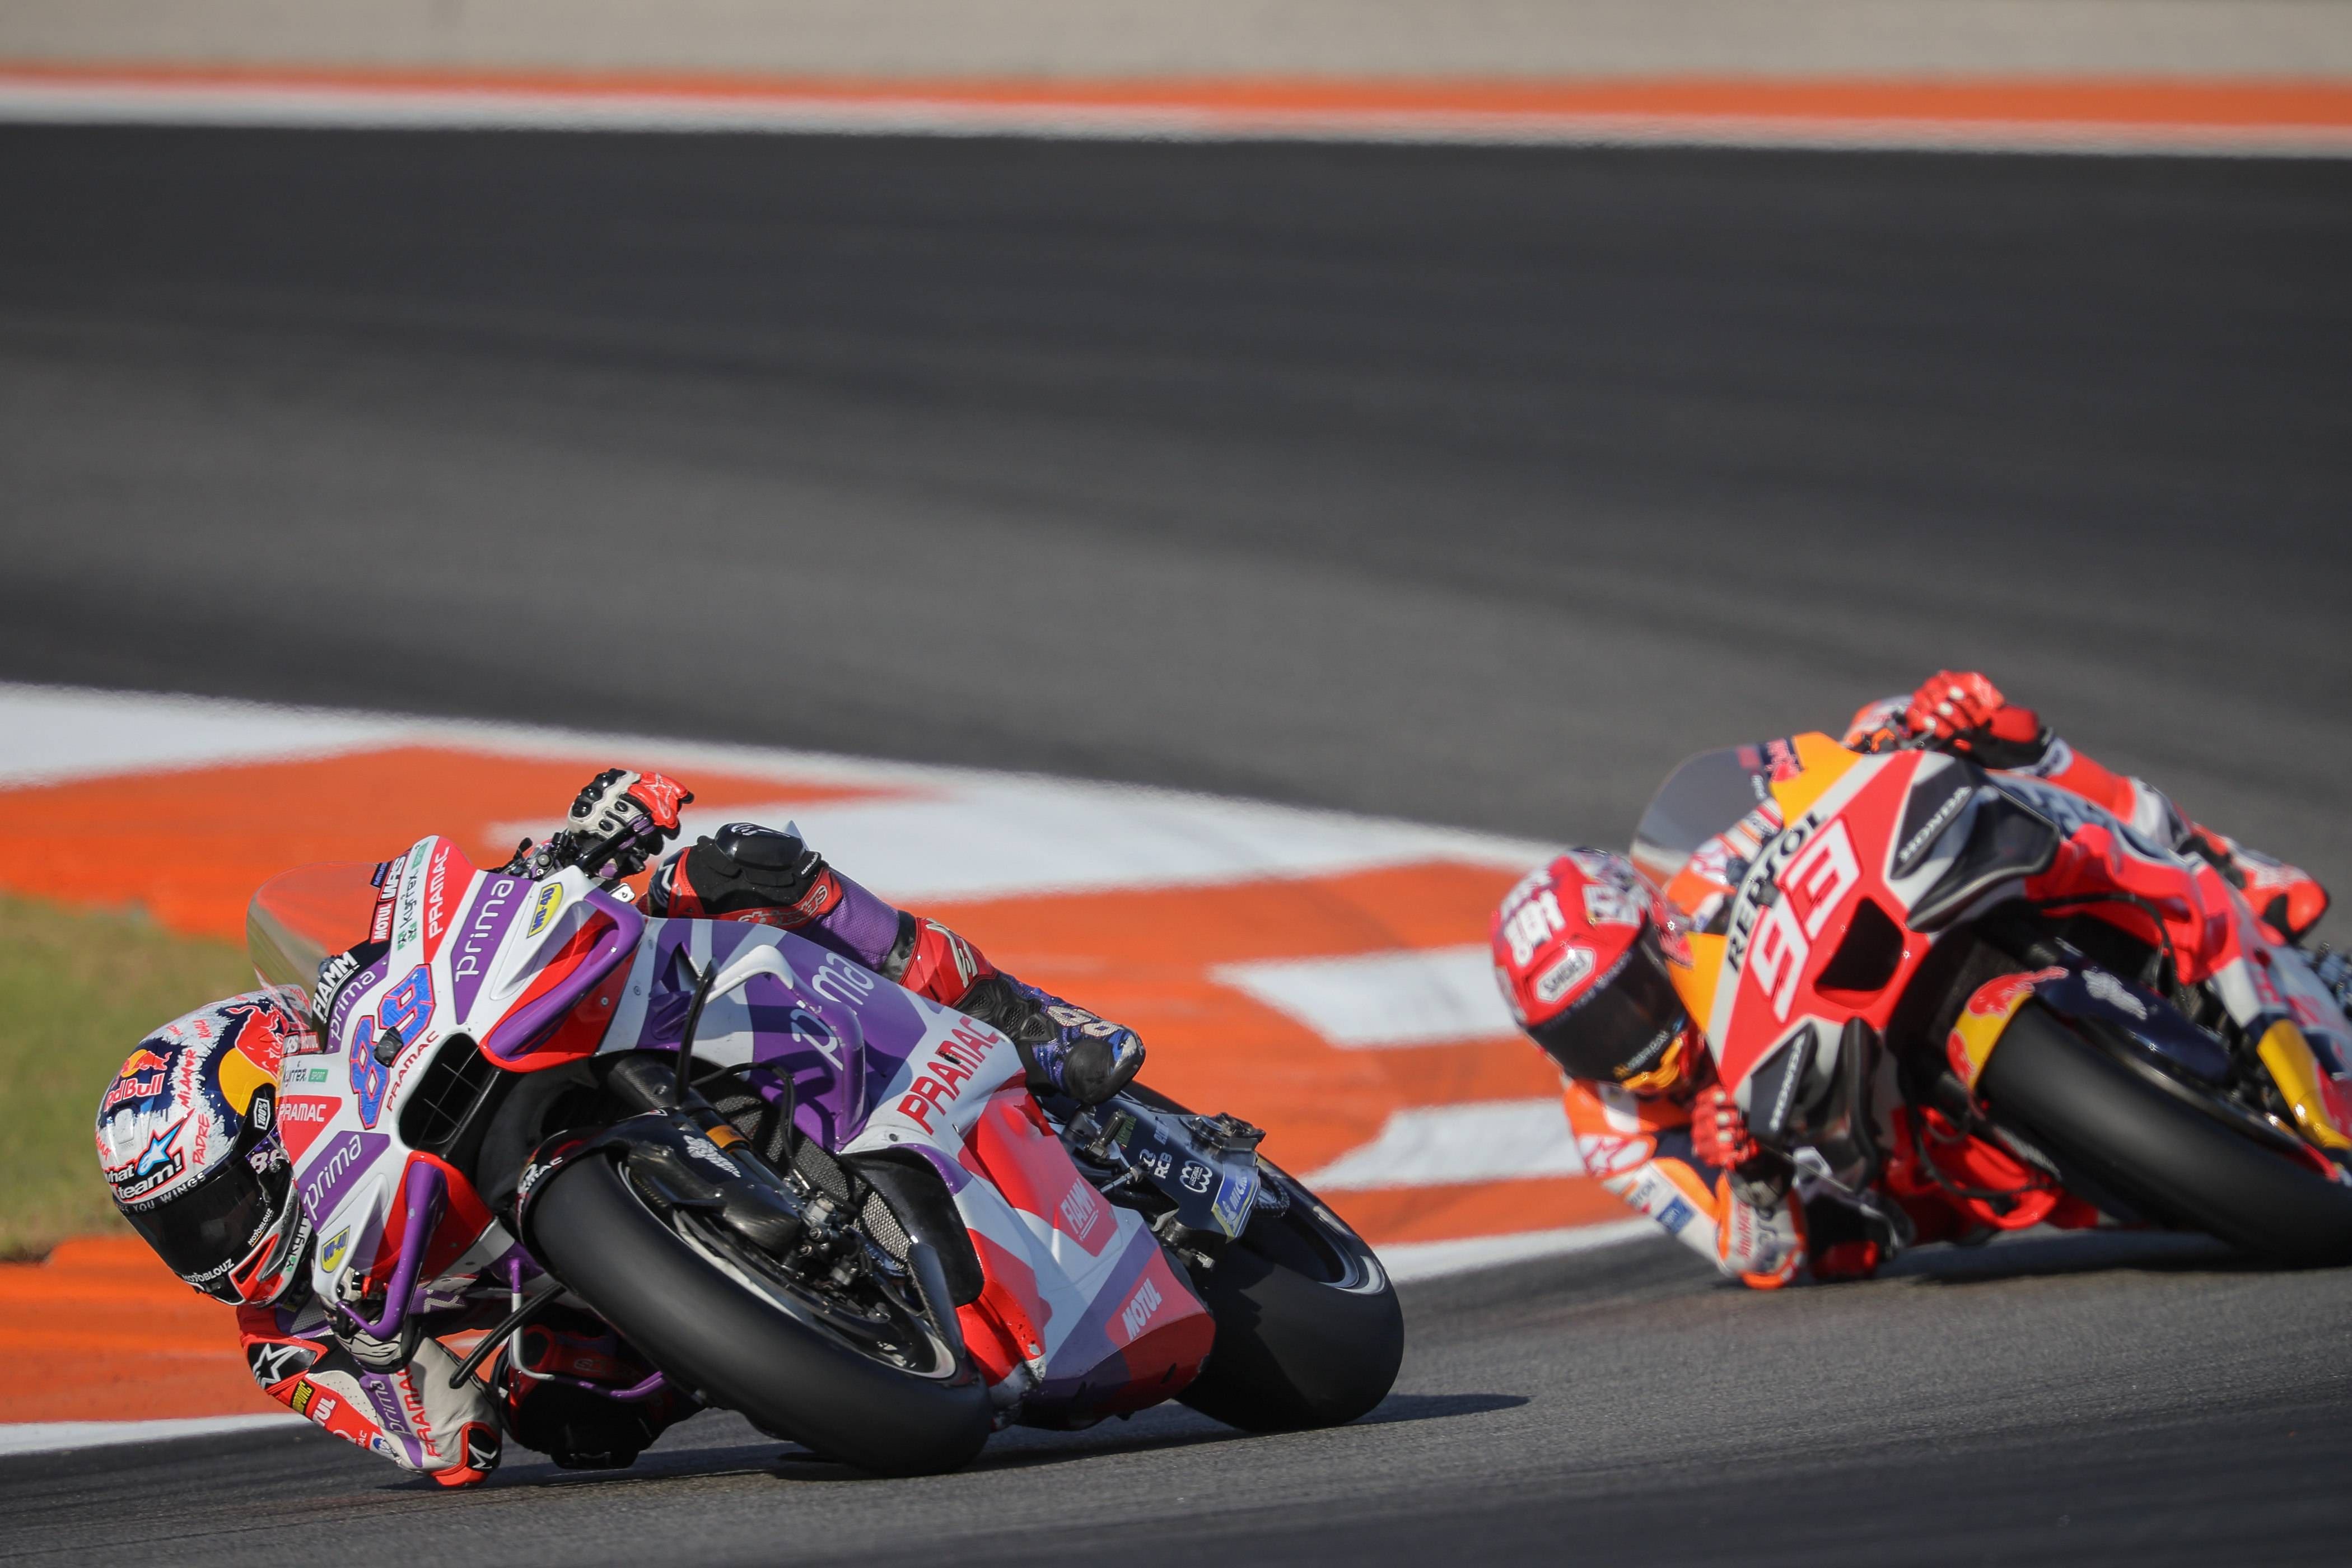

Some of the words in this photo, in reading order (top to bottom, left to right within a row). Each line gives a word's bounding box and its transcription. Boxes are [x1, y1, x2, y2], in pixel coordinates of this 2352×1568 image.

[374, 903, 392, 940] MOTUL
[428, 846, 450, 939] PRAMAC
[1750, 818, 1860, 1022] 93
[455, 880, 515, 982] prima
[312, 951, 358, 1021] FIAMM
[331, 970, 376, 1042] prima
[790, 952, 874, 1071] pma
[349, 964, 437, 1130] 89
[386, 1030, 440, 1111] PRAMAC
[897, 1015, 1001, 1136] PRAMAC
[123, 1072, 165, 1100] Bull
[278, 1103, 326, 1122] PRAMAC
[192, 1113, 211, 1165] PADRE
[1154, 1152, 1173, 1179] RCB
[118, 1152, 183, 1200] team!
[133, 1201, 155, 1214] YOU
[160, 1172, 206, 1203] WINGS
[304, 1134, 362, 1221] prima
[1189, 1166, 1200, 1187] REGINA
[247, 1207, 273, 1246] MOTOBLOUZ
[1060, 1178, 1096, 1235] FIAMM
[1122, 1278, 1163, 1342] MOTUL
[312, 1397, 336, 1426] TUL
